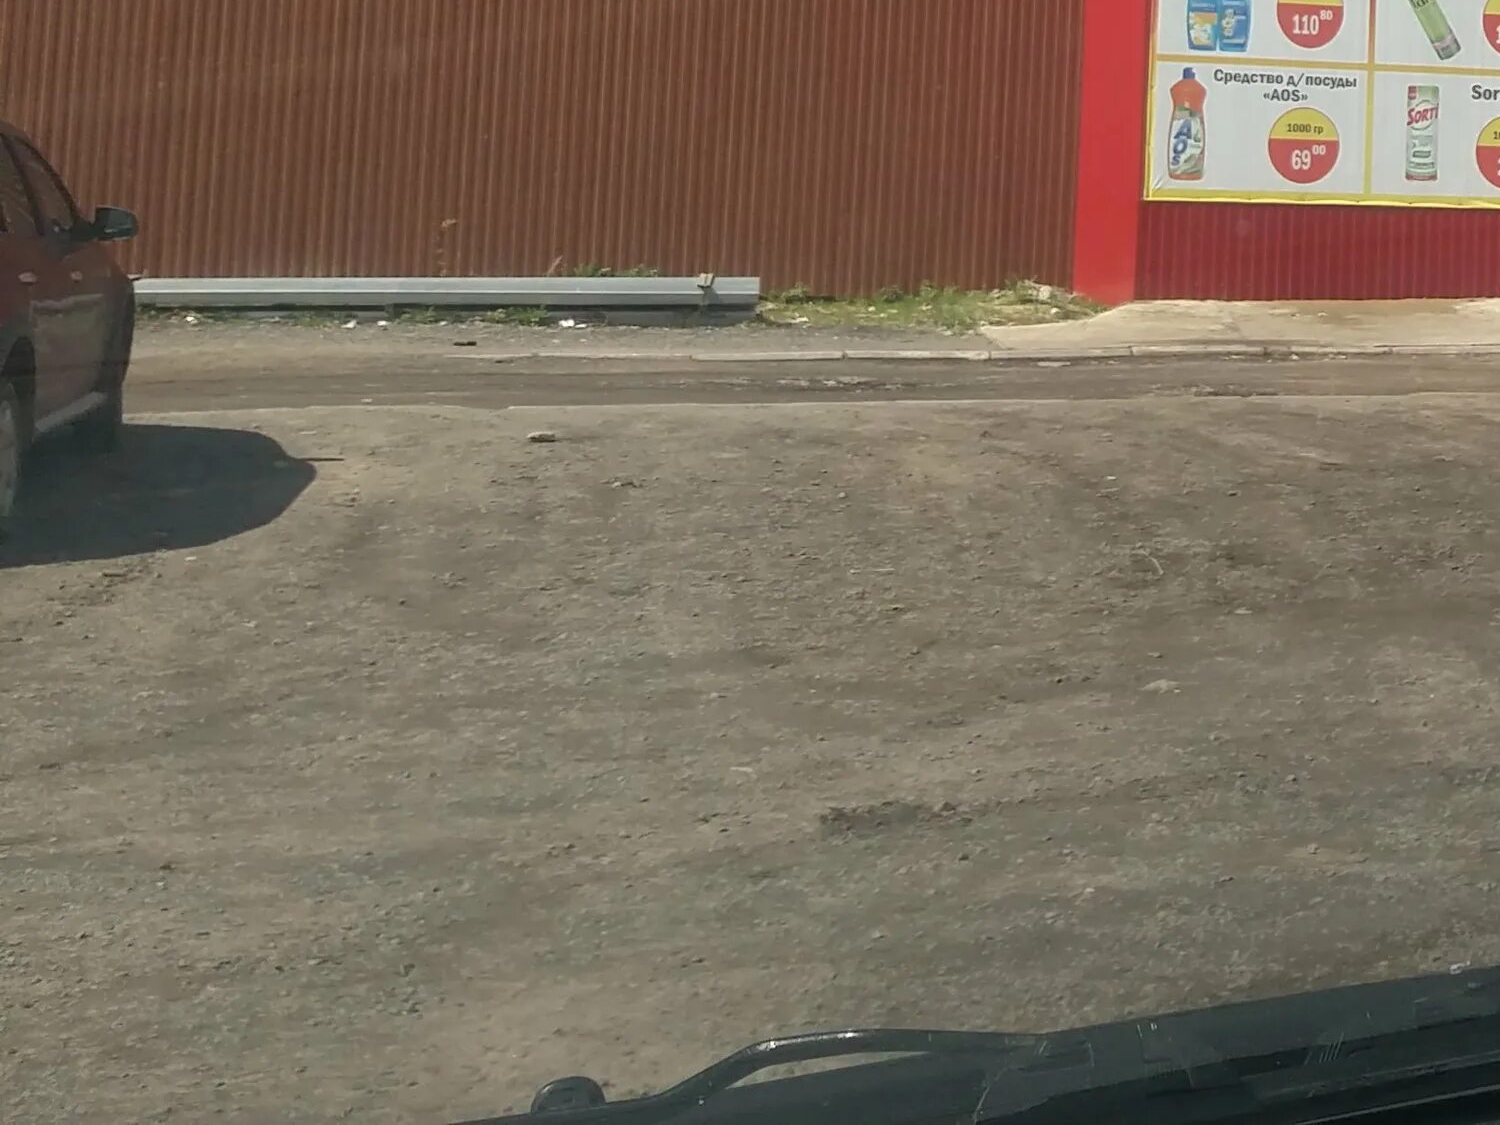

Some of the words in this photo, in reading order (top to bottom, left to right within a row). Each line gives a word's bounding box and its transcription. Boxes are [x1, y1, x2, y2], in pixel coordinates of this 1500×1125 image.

[1291, 14, 1320, 35] 110
[1320, 10, 1333, 21] 80
[1214, 69, 1284, 86] Средство
[1263, 89, 1308, 102] «AOS»
[1287, 123, 1311, 133] 1000
[1313, 125, 1324, 135] гр
[1291, 149, 1312, 170] 69
[1312, 144, 1327, 156] 00
